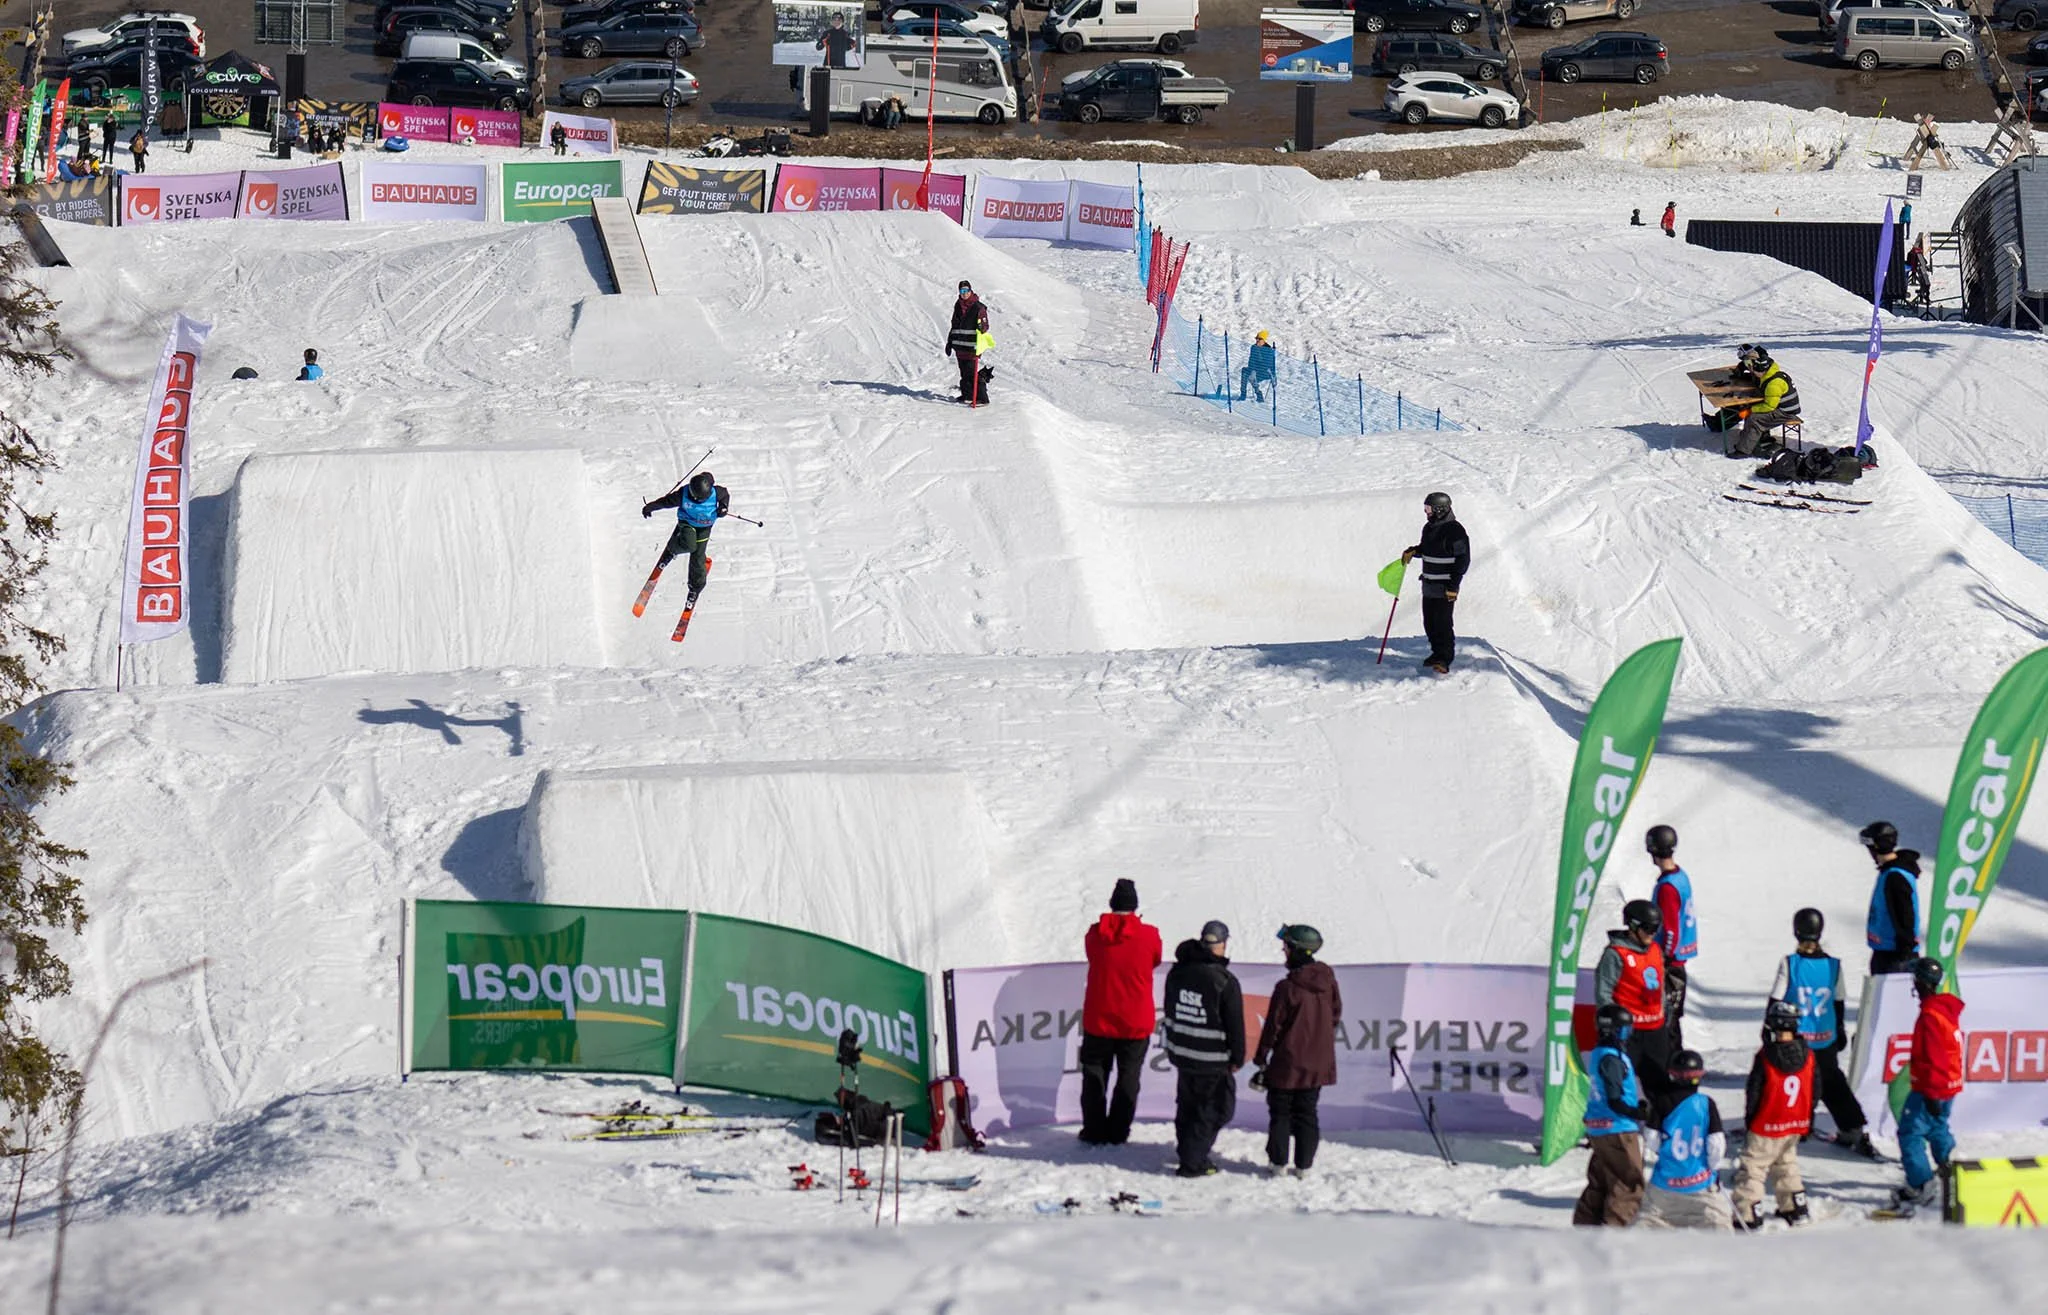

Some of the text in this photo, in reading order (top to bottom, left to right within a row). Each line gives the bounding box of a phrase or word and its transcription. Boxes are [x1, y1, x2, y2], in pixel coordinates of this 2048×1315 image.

[403, 116, 446, 126] SVENSKA
[478, 120, 518, 130] SVENSKA
[403, 125, 426, 134] SPEL
[477, 129, 499, 137] SPEL
[568, 128, 607, 140] UHAUS
[166, 190, 232, 206] SVENSKA
[282, 183, 339, 200] SVENSKA
[373, 186, 476, 203] BAUHAUS
[514, 181, 612, 206] Europcar
[662, 186, 750, 201] GET OUT THERE WITH
[821, 186, 877, 199] SVENSKA
[55, 202, 66, 212] BY
[680, 198, 705, 210] YOUR
[928, 192, 961, 207] VENSKA
[165, 207, 200, 220] SPEL
[281, 202, 313, 214] SPEL
[986, 201, 1064, 219] BAUHAUS
[1081, 206, 1133, 225] BAUHAUS
[1938, 738, 2012, 958] opcar
[1797, 986, 1832, 1017] 52
[1783, 1075, 1801, 1107] 9
[1671, 1125, 1705, 1161] 66
